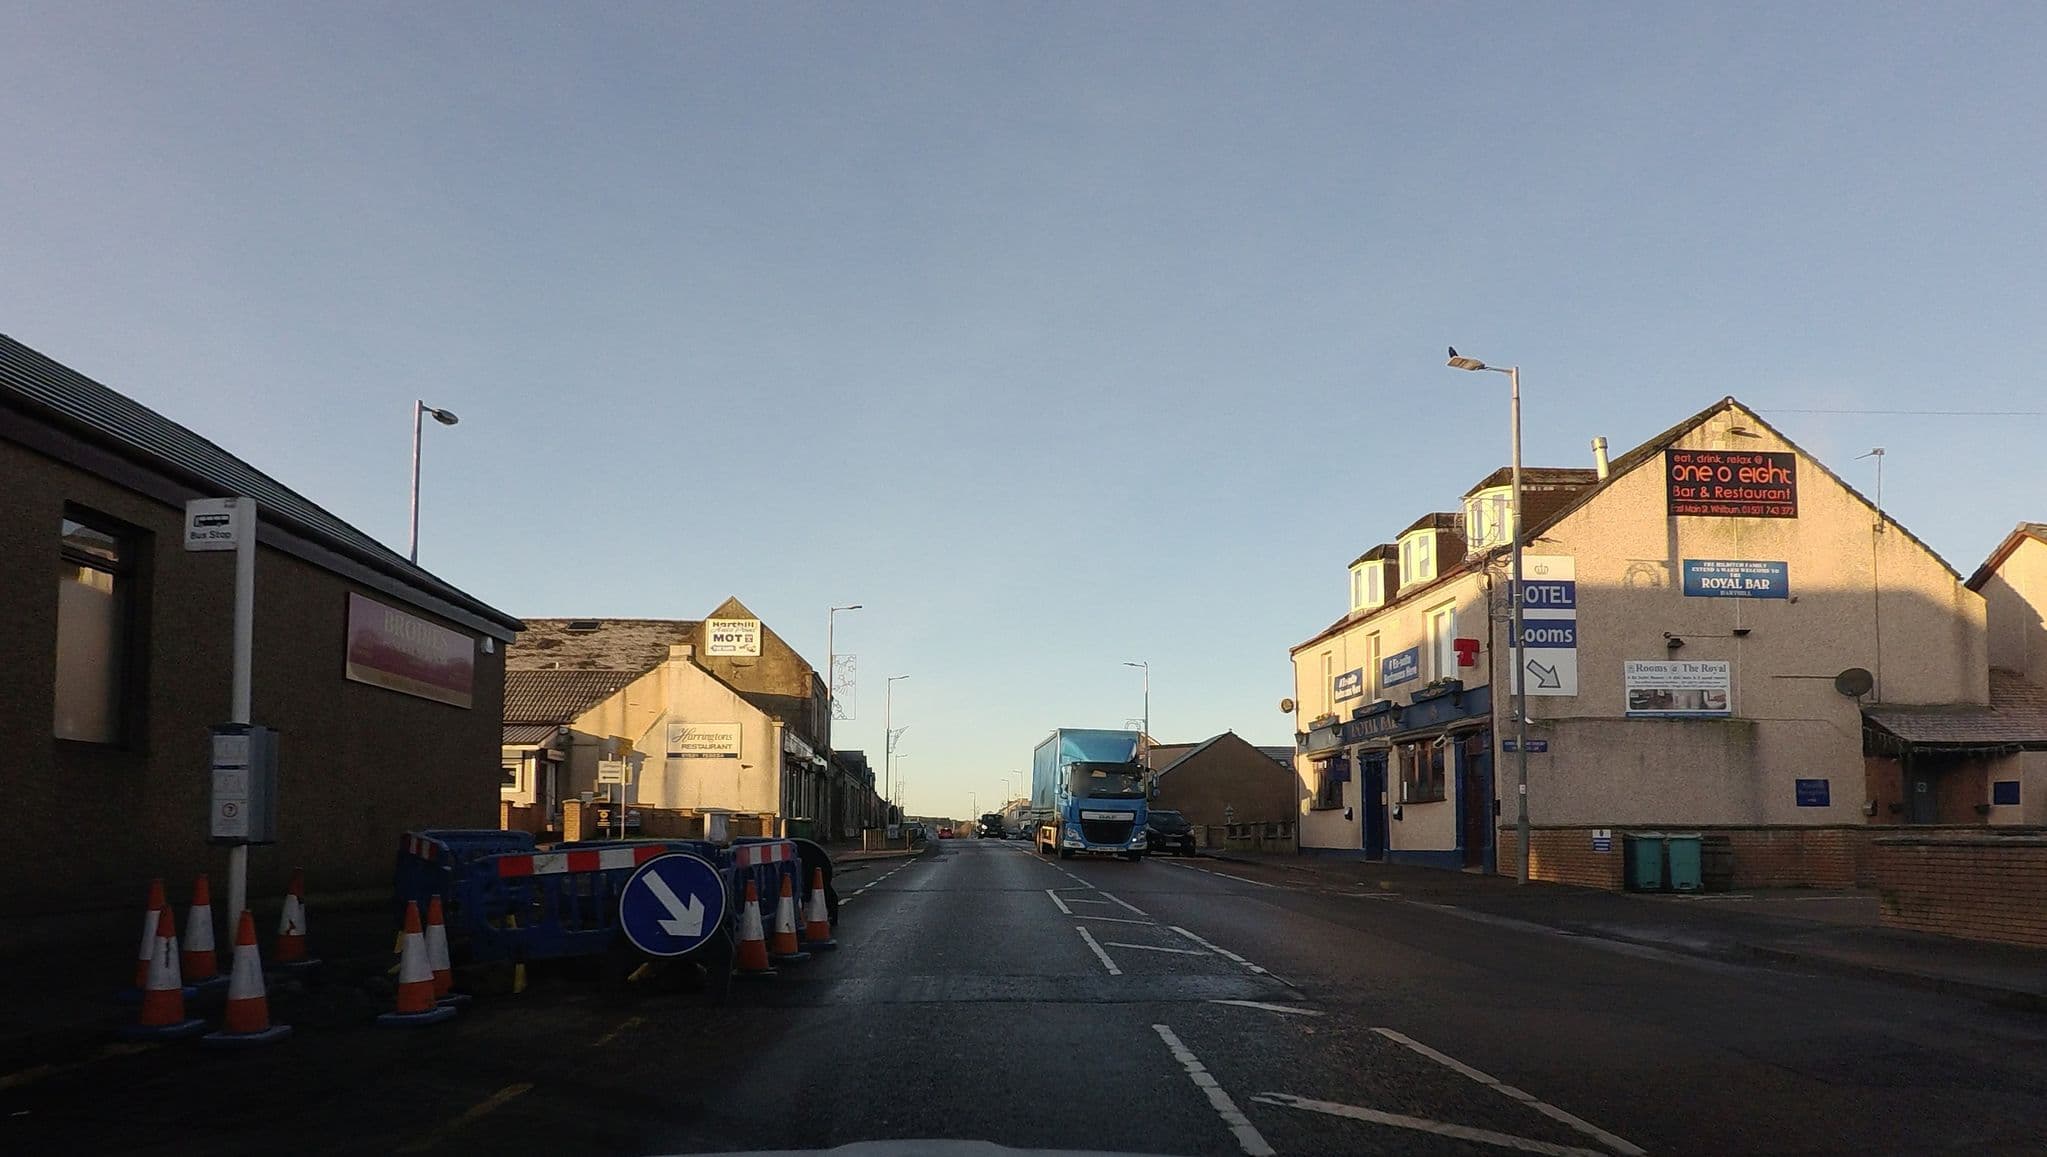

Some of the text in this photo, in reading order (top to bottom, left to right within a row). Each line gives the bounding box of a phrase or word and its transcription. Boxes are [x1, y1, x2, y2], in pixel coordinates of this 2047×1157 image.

[1674, 455, 1694, 463] eat,
[1727, 456, 1752, 464] relax
[1672, 465, 1713, 482] one
[1738, 458, 1792, 484] eight
[1673, 486, 1791, 500] Bar & Restaurant
[190, 530, 232, 541] Bus Stop
[1701, 577, 1770, 590] ROYAL BAR
[713, 634, 743, 642] MOT
[1520, 628, 1573, 643] ooms
[1636, 663, 1668, 673] Rooms
[1682, 664, 1699, 673] The
[1701, 664, 1727, 675] Royal
[671, 727, 733, 743] Harringtons
